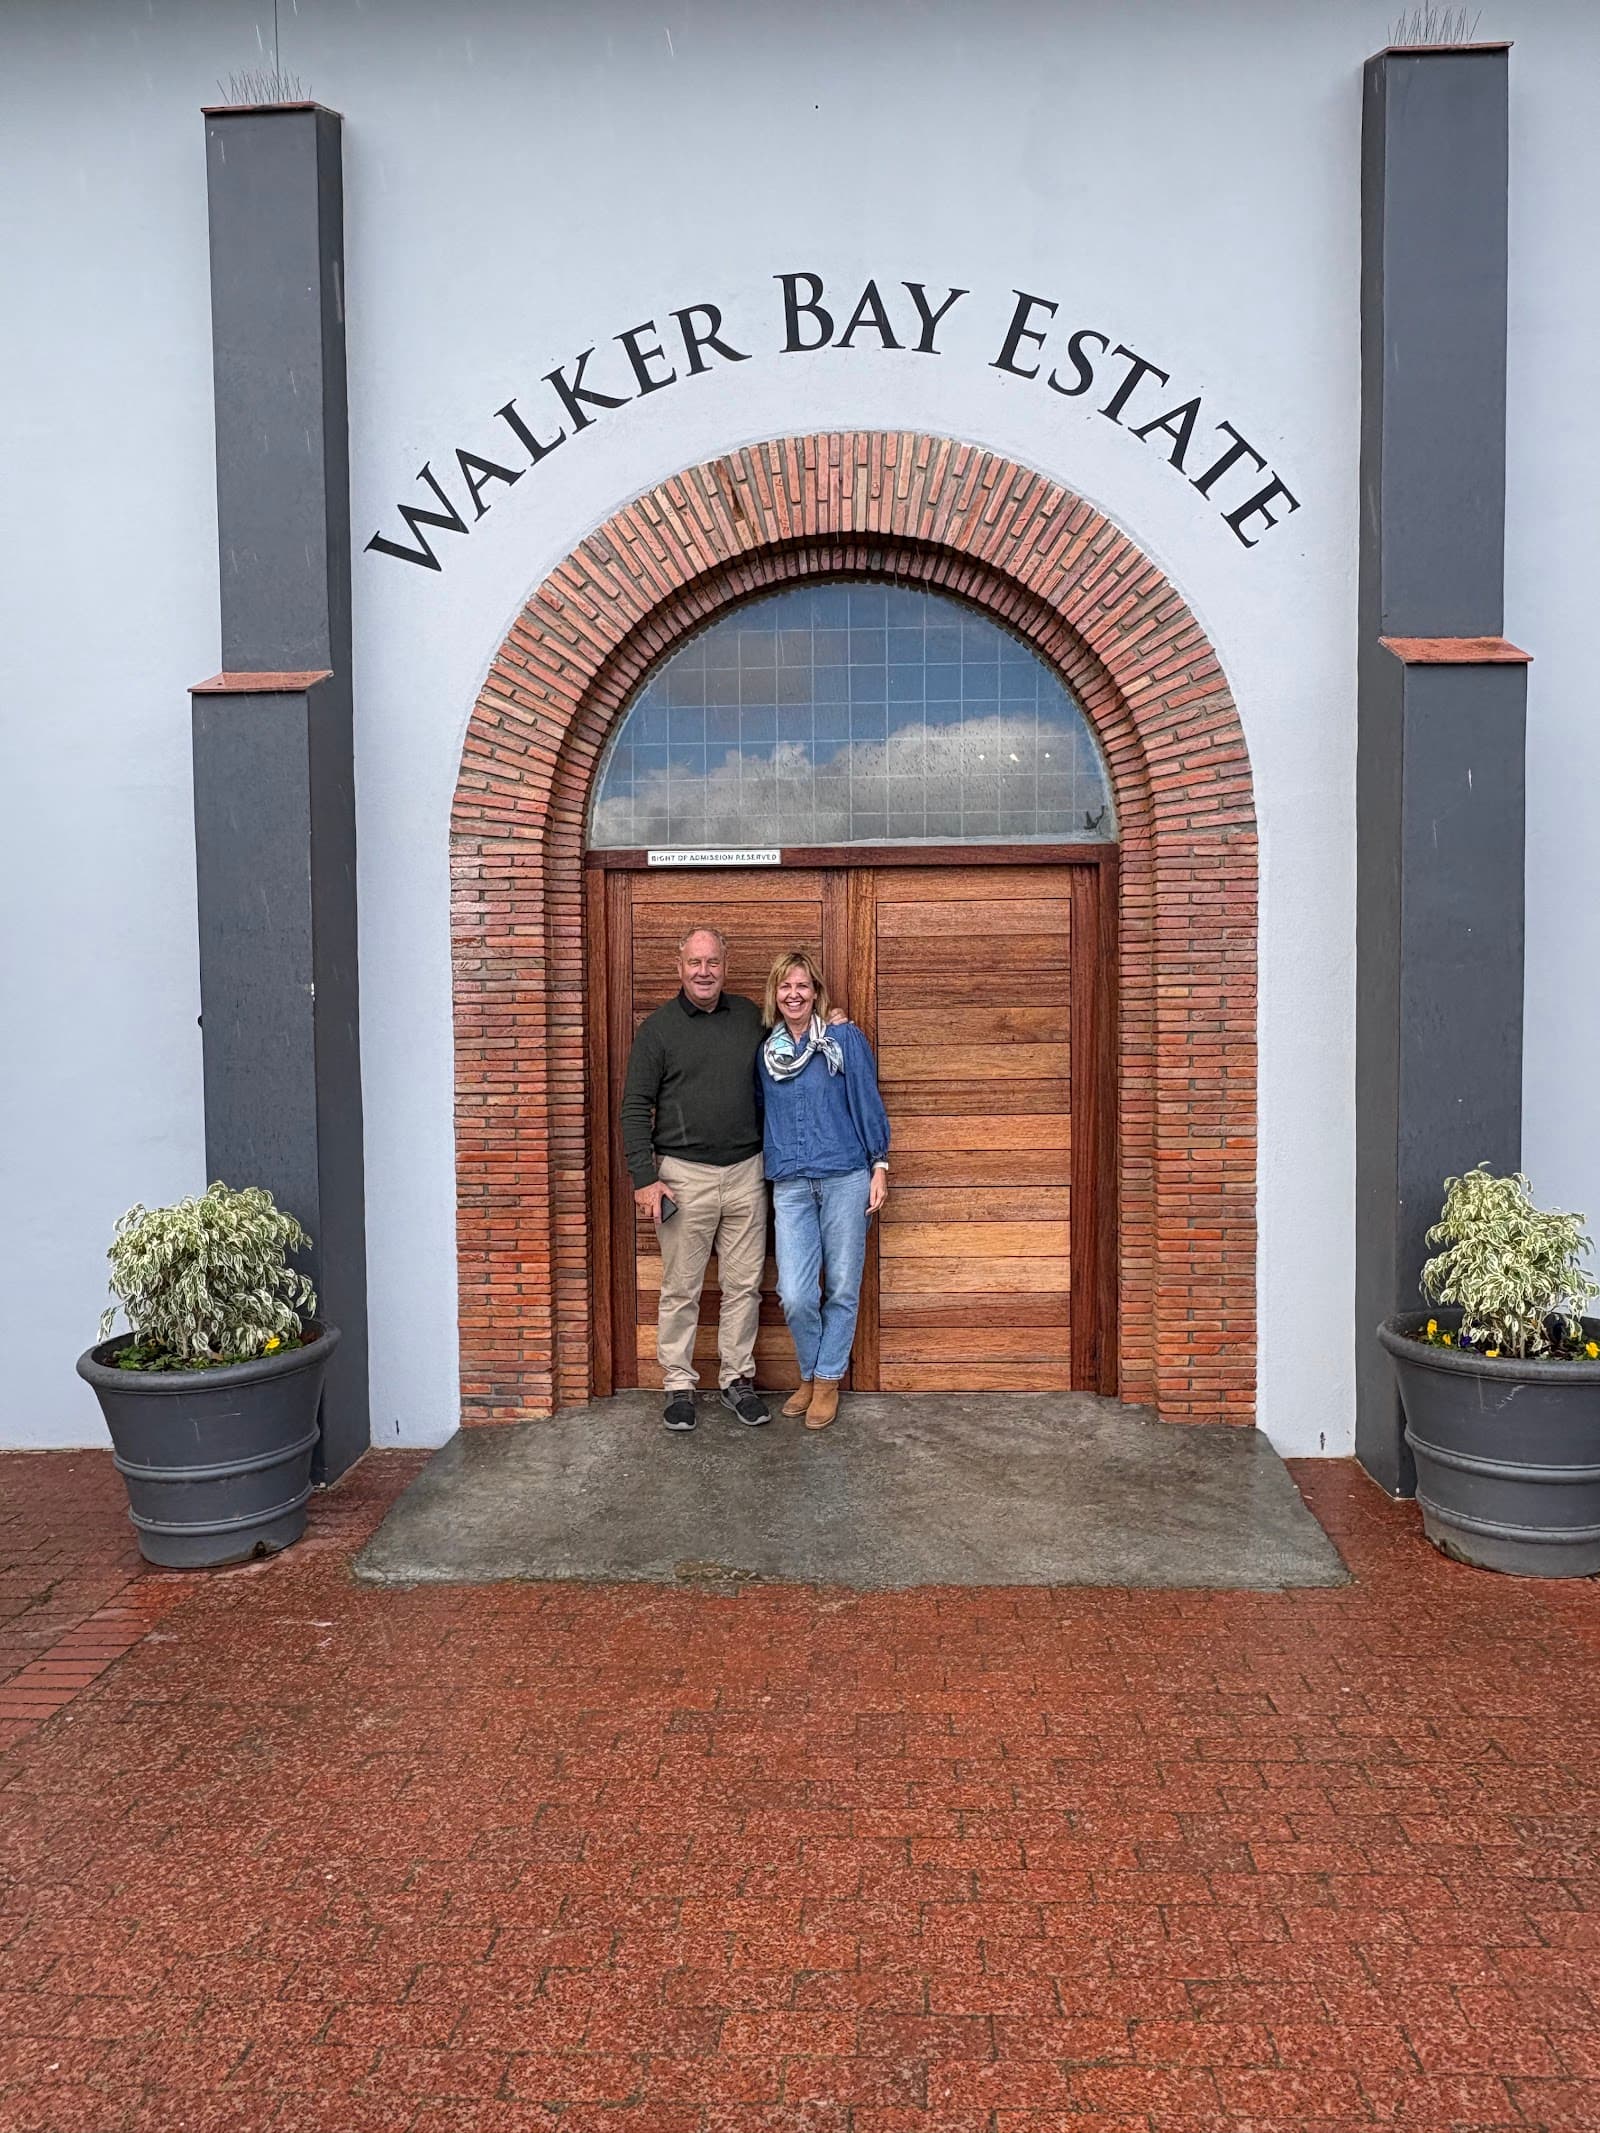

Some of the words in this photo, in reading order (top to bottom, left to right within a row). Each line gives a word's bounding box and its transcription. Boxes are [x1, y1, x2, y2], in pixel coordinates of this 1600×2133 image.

[364, 304, 752, 571] WALKER
[773, 273, 969, 354] BAY
[989, 290, 1300, 548] ESTATE
